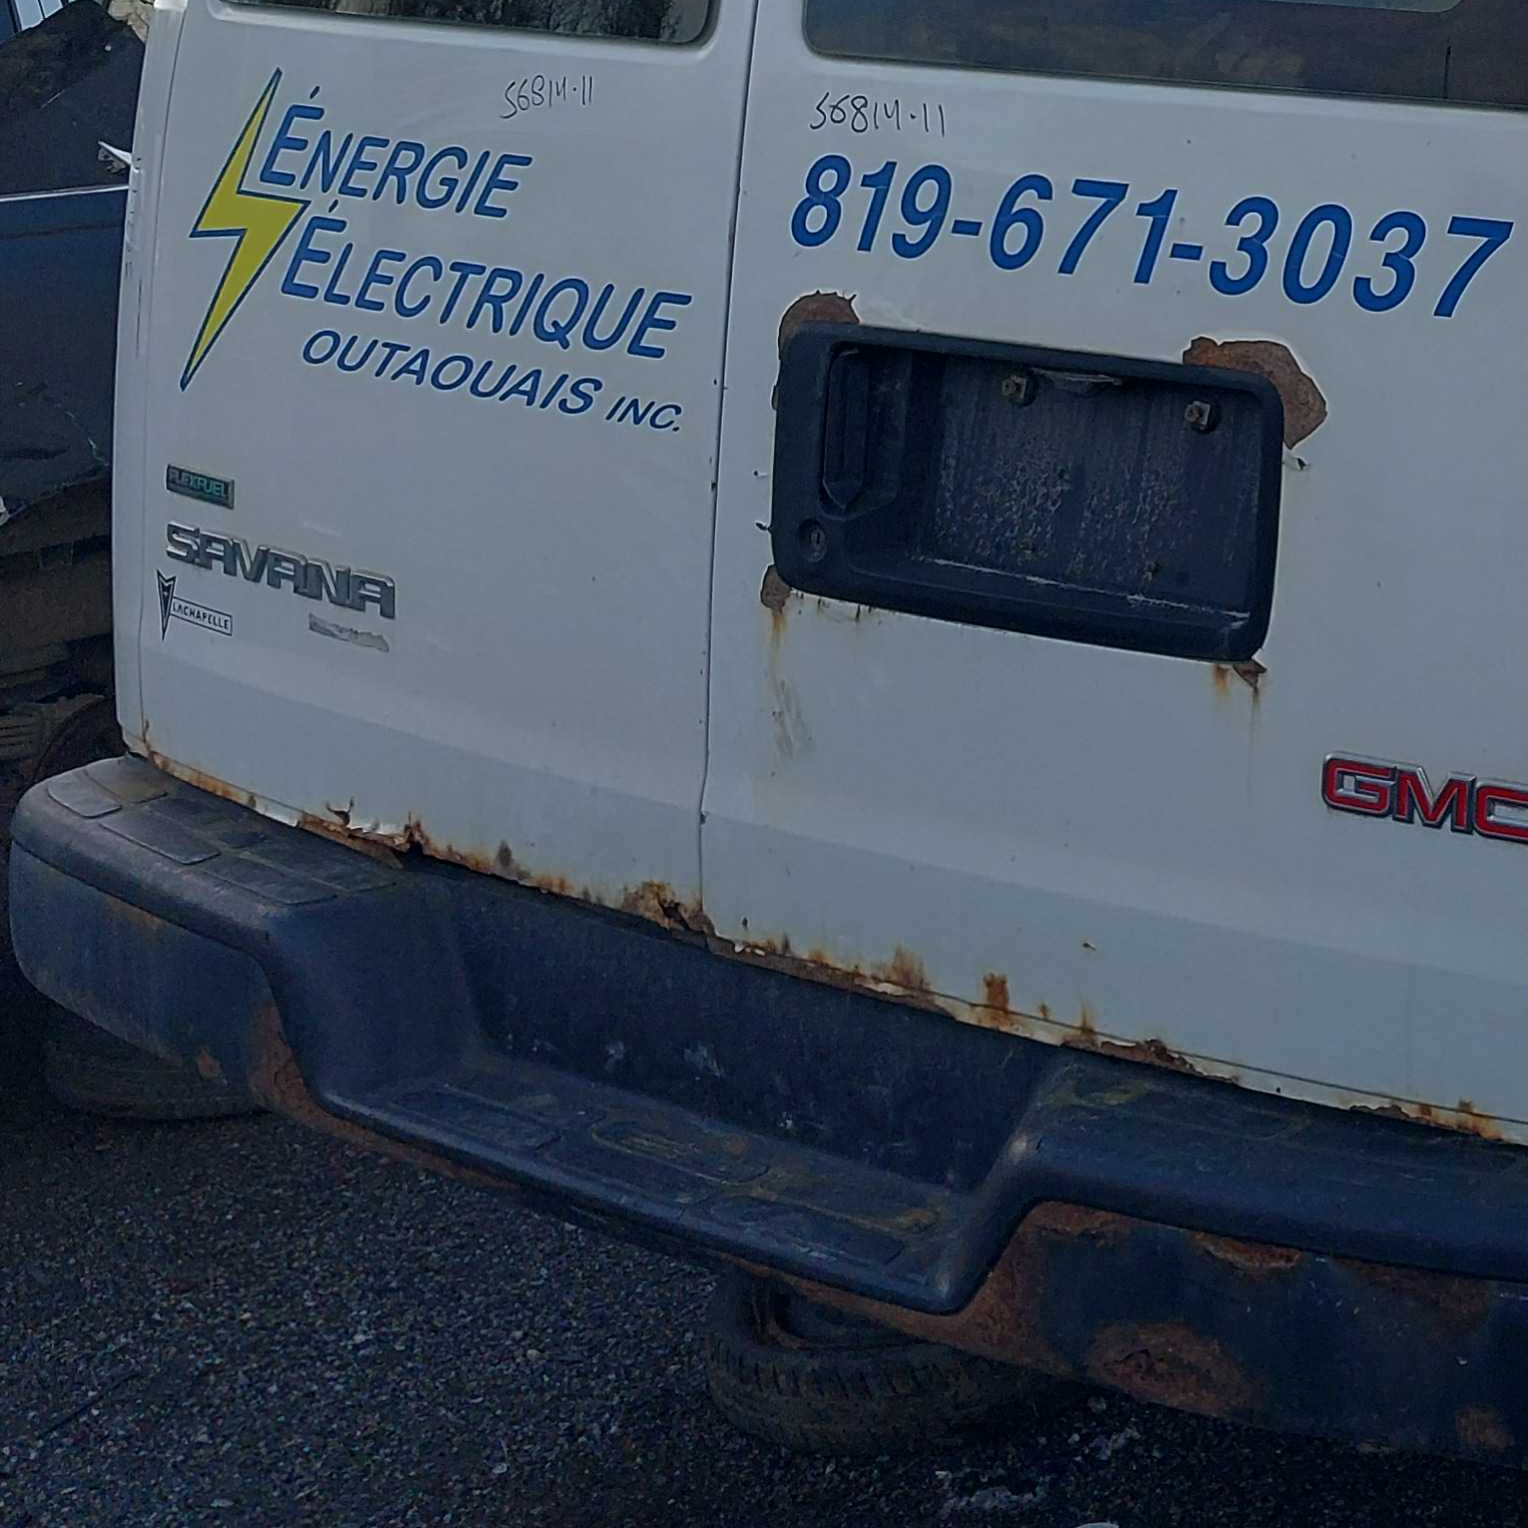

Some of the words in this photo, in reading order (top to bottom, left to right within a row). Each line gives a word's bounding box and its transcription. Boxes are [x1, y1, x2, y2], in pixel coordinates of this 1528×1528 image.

[259, 85, 533, 219] ÉNERGIE
[280, 199, 693, 359] ÉLECTRIQUE
[789, 154, 1515, 319] 819-671-3037
[301, 329, 603, 415] OUTAOUAIS
[605, 395, 684, 432] INC.
[165, 520, 396, 621] SAVANA
